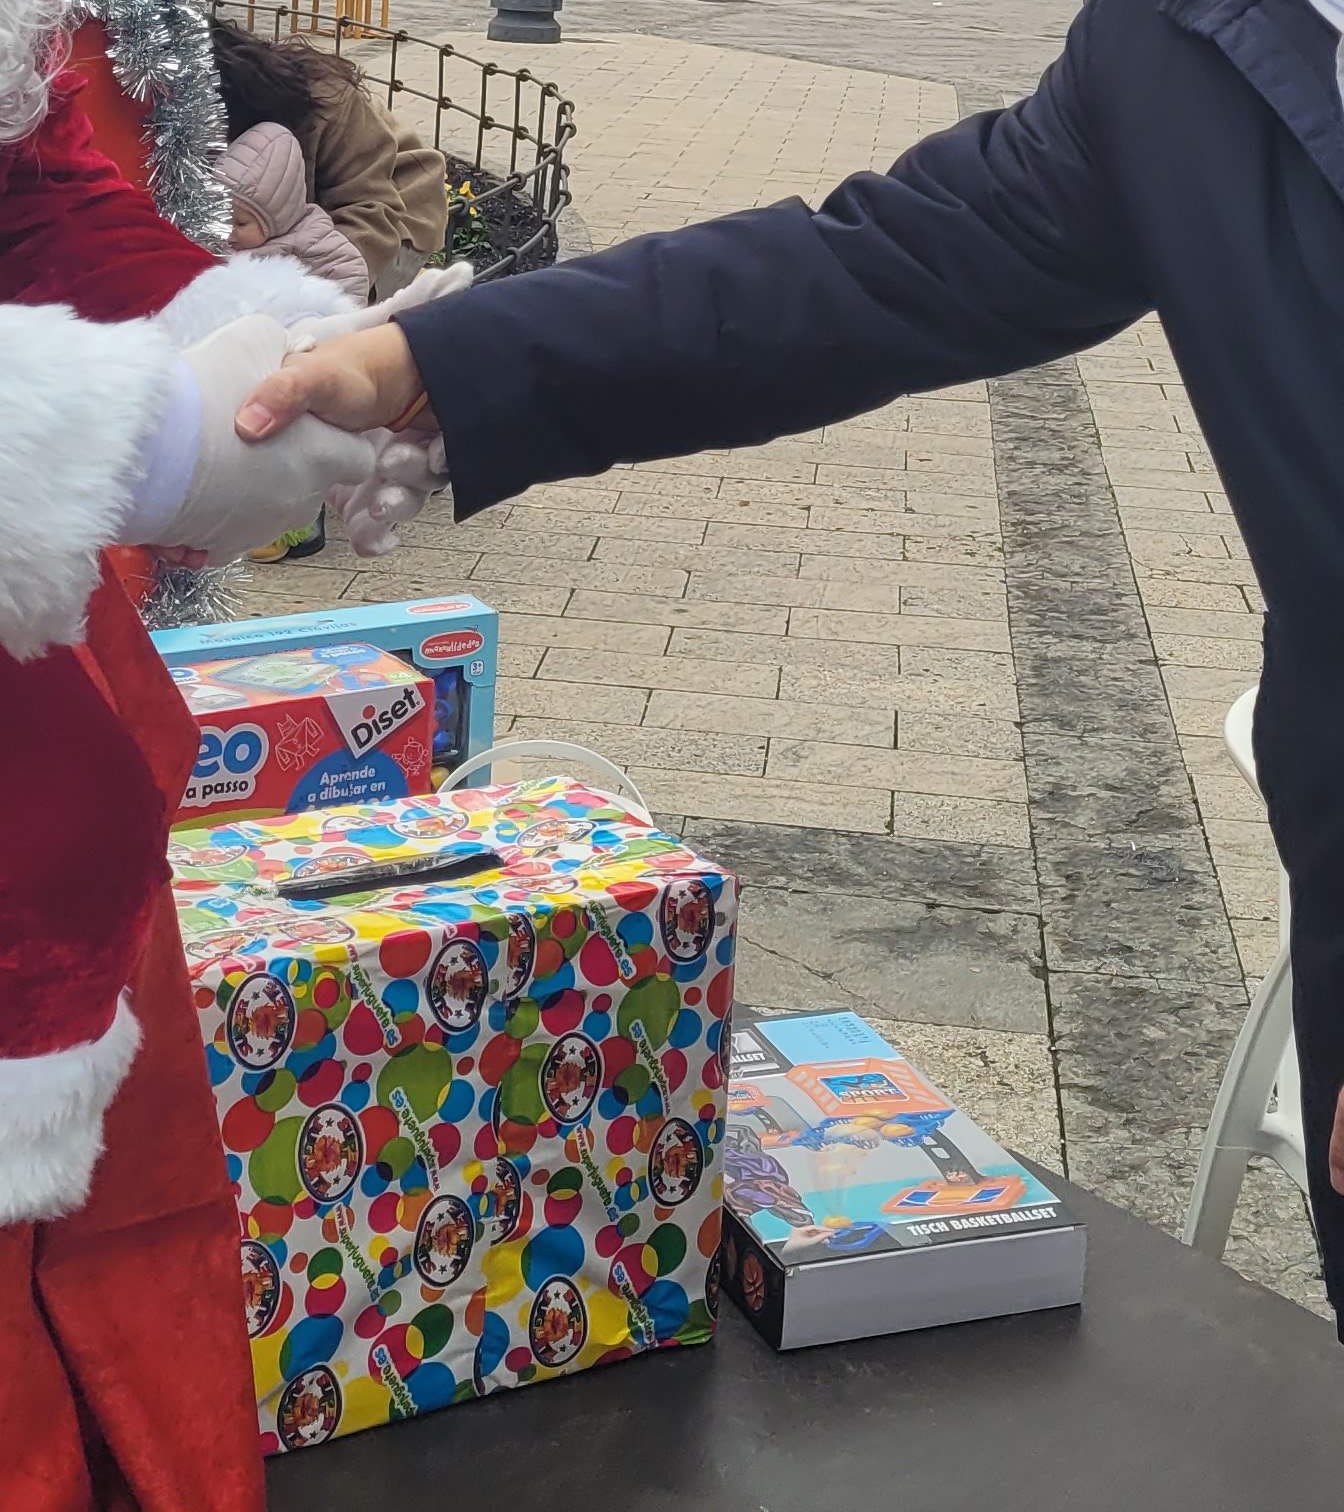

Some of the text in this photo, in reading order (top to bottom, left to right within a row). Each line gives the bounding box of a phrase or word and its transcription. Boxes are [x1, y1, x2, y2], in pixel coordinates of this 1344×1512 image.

[350, 686, 418, 750] Diset
[193, 729, 263, 779] eo
[319, 765, 376, 786] Aprende
[185, 779, 249, 800] a passo
[307, 792, 316, 803] a
[370, 781, 386, 791] en
[731, 1052, 766, 1064] ALLSET
[906, 1206, 1058, 1237] TISCH BASKETBALLSET
